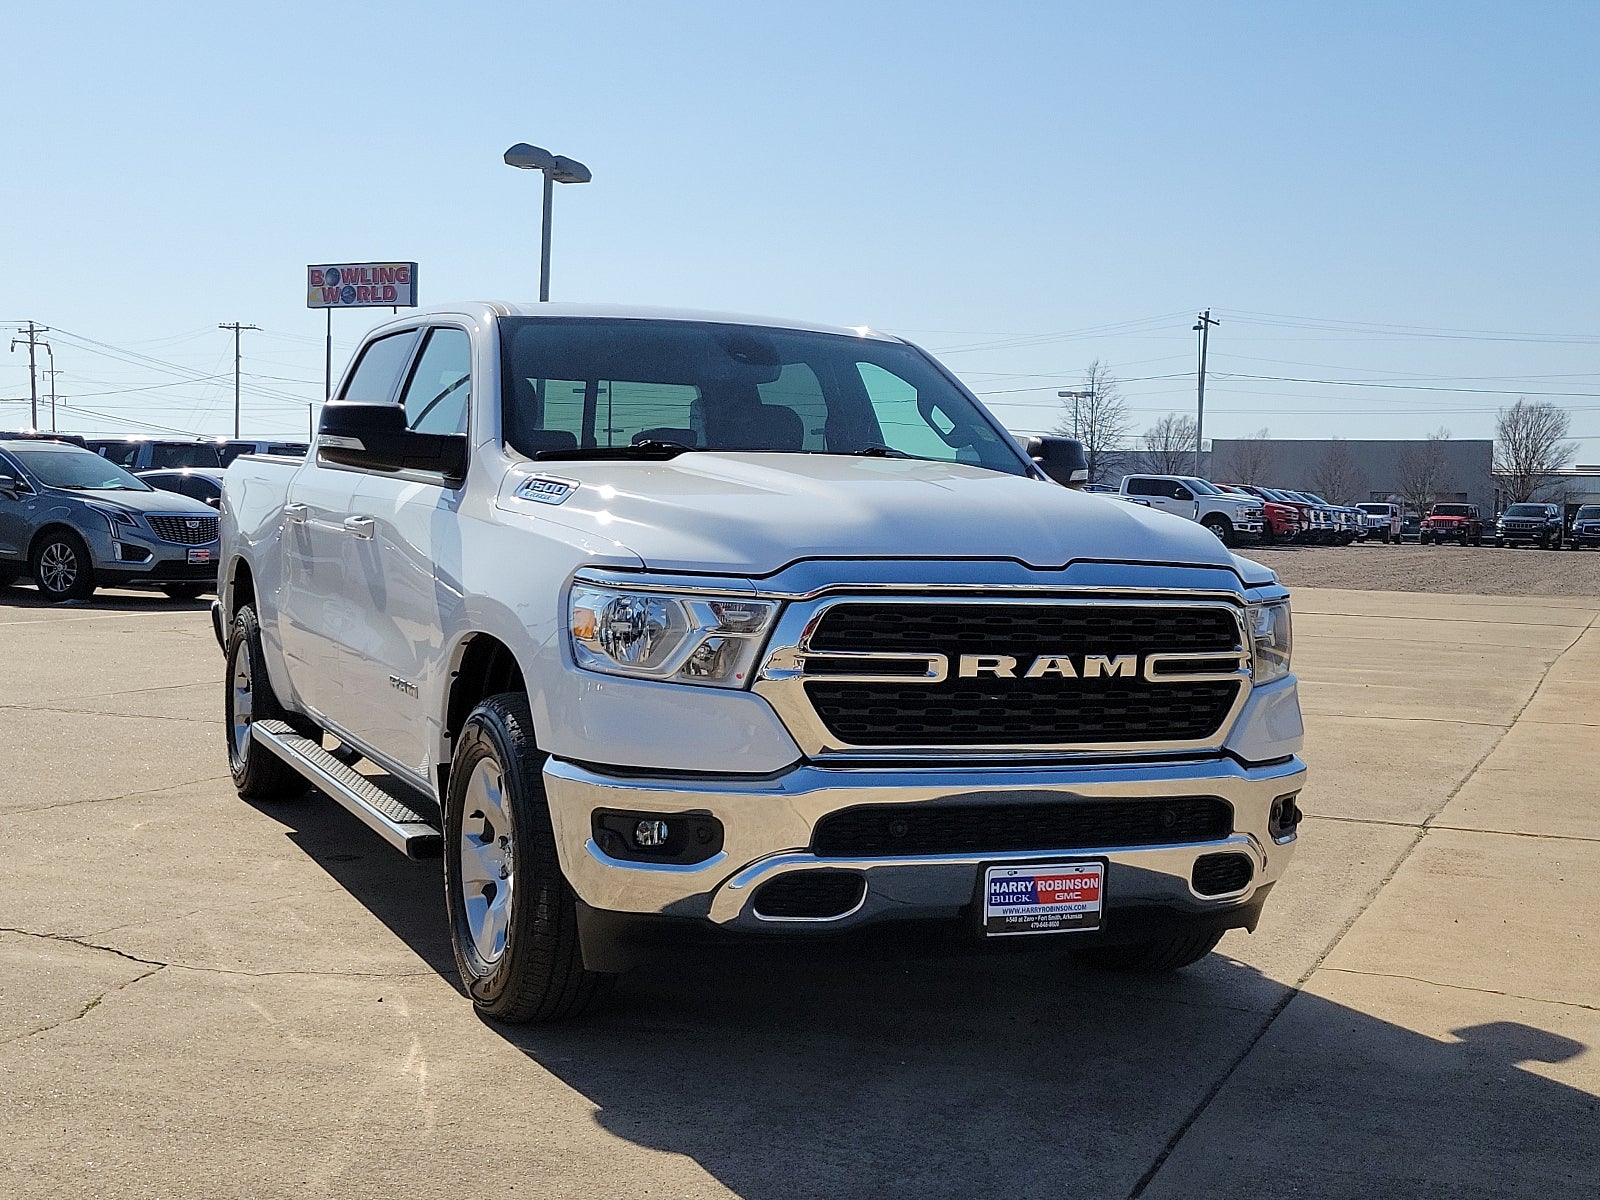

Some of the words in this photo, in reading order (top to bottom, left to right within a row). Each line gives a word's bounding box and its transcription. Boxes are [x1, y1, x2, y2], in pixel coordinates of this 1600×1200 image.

[311, 267, 409, 286] BOWLING
[321, 285, 398, 304] WORLD
[528, 481, 568, 495] 1500
[958, 654, 1138, 678] RAM
[991, 881, 1034, 893] HARRY
[1037, 878, 1099, 891] ROBINSON
[991, 894, 1032, 903] BUICK
[1055, 892, 1082, 900] GMC
[1002, 904, 1087, 914] WWW.HARRYROBINSON.COM
